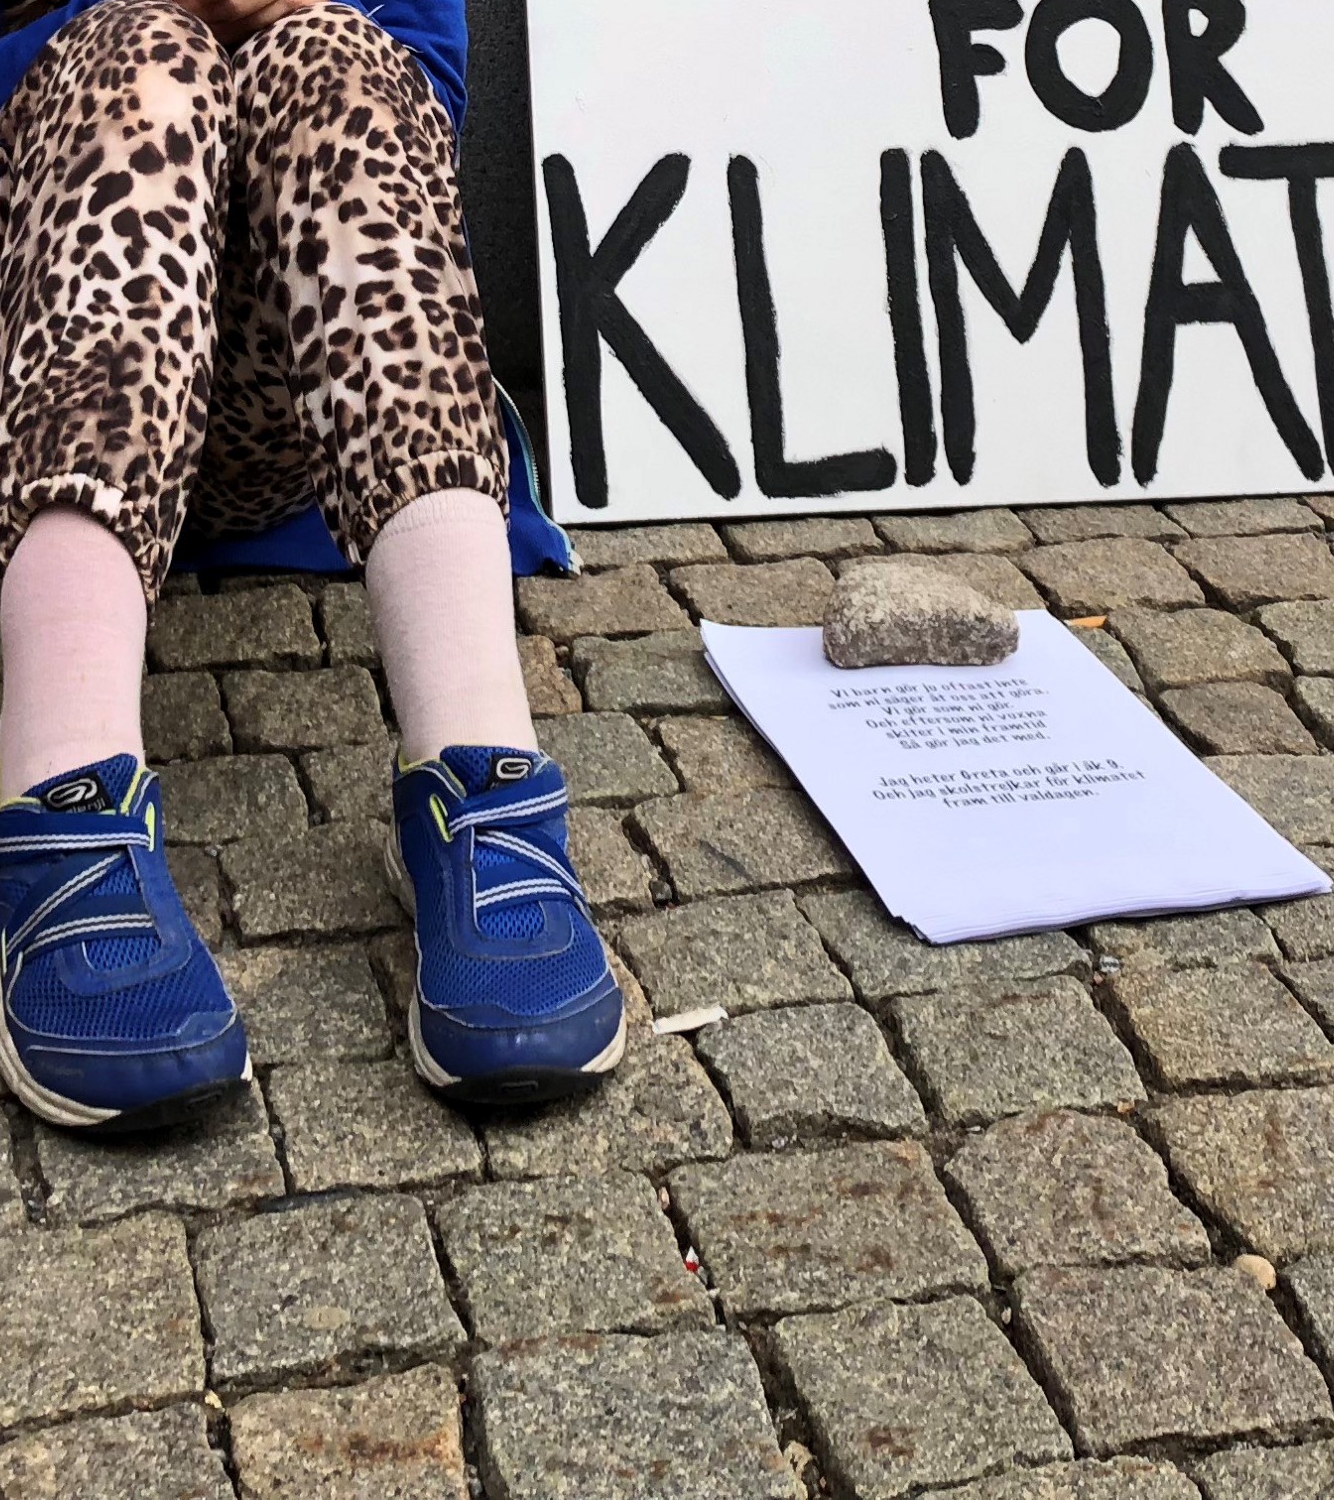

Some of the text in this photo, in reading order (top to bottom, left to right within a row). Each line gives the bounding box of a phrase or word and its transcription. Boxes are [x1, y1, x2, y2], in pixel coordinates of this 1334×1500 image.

[830, 688, 849, 698] Vi
[850, 686, 892, 697] barn
[895, 683, 918, 694] gör
[941, 681, 992, 691] oftast
[994, 678, 1028, 688] inte
[828, 688, 1049, 710] som ni säger åt oss att göra.
[882, 706, 901, 715] Vi
[903, 705, 927, 716] gör
[932, 704, 965, 713] som
[968, 702, 984, 712] ni
[865, 709, 1048, 729] Och eftersom ni vuxna
[886, 728, 934, 739] skiter
[947, 725, 980, 735] min
[982, 719, 1048, 733] framtid
[899, 731, 1051, 750] Så gör jag det med.
[878, 776, 910, 788] Jag
[908, 773, 956, 785] heter
[959, 768, 1010, 781] Greta
[1012, 763, 1043, 776] och
[1044, 761, 1070, 775] går
[1082, 759, 1106, 771] åk
[872, 770, 1147, 800] Och jag skolstrejkar för klimatet
[942, 788, 1101, 809] fram till valdagen.
